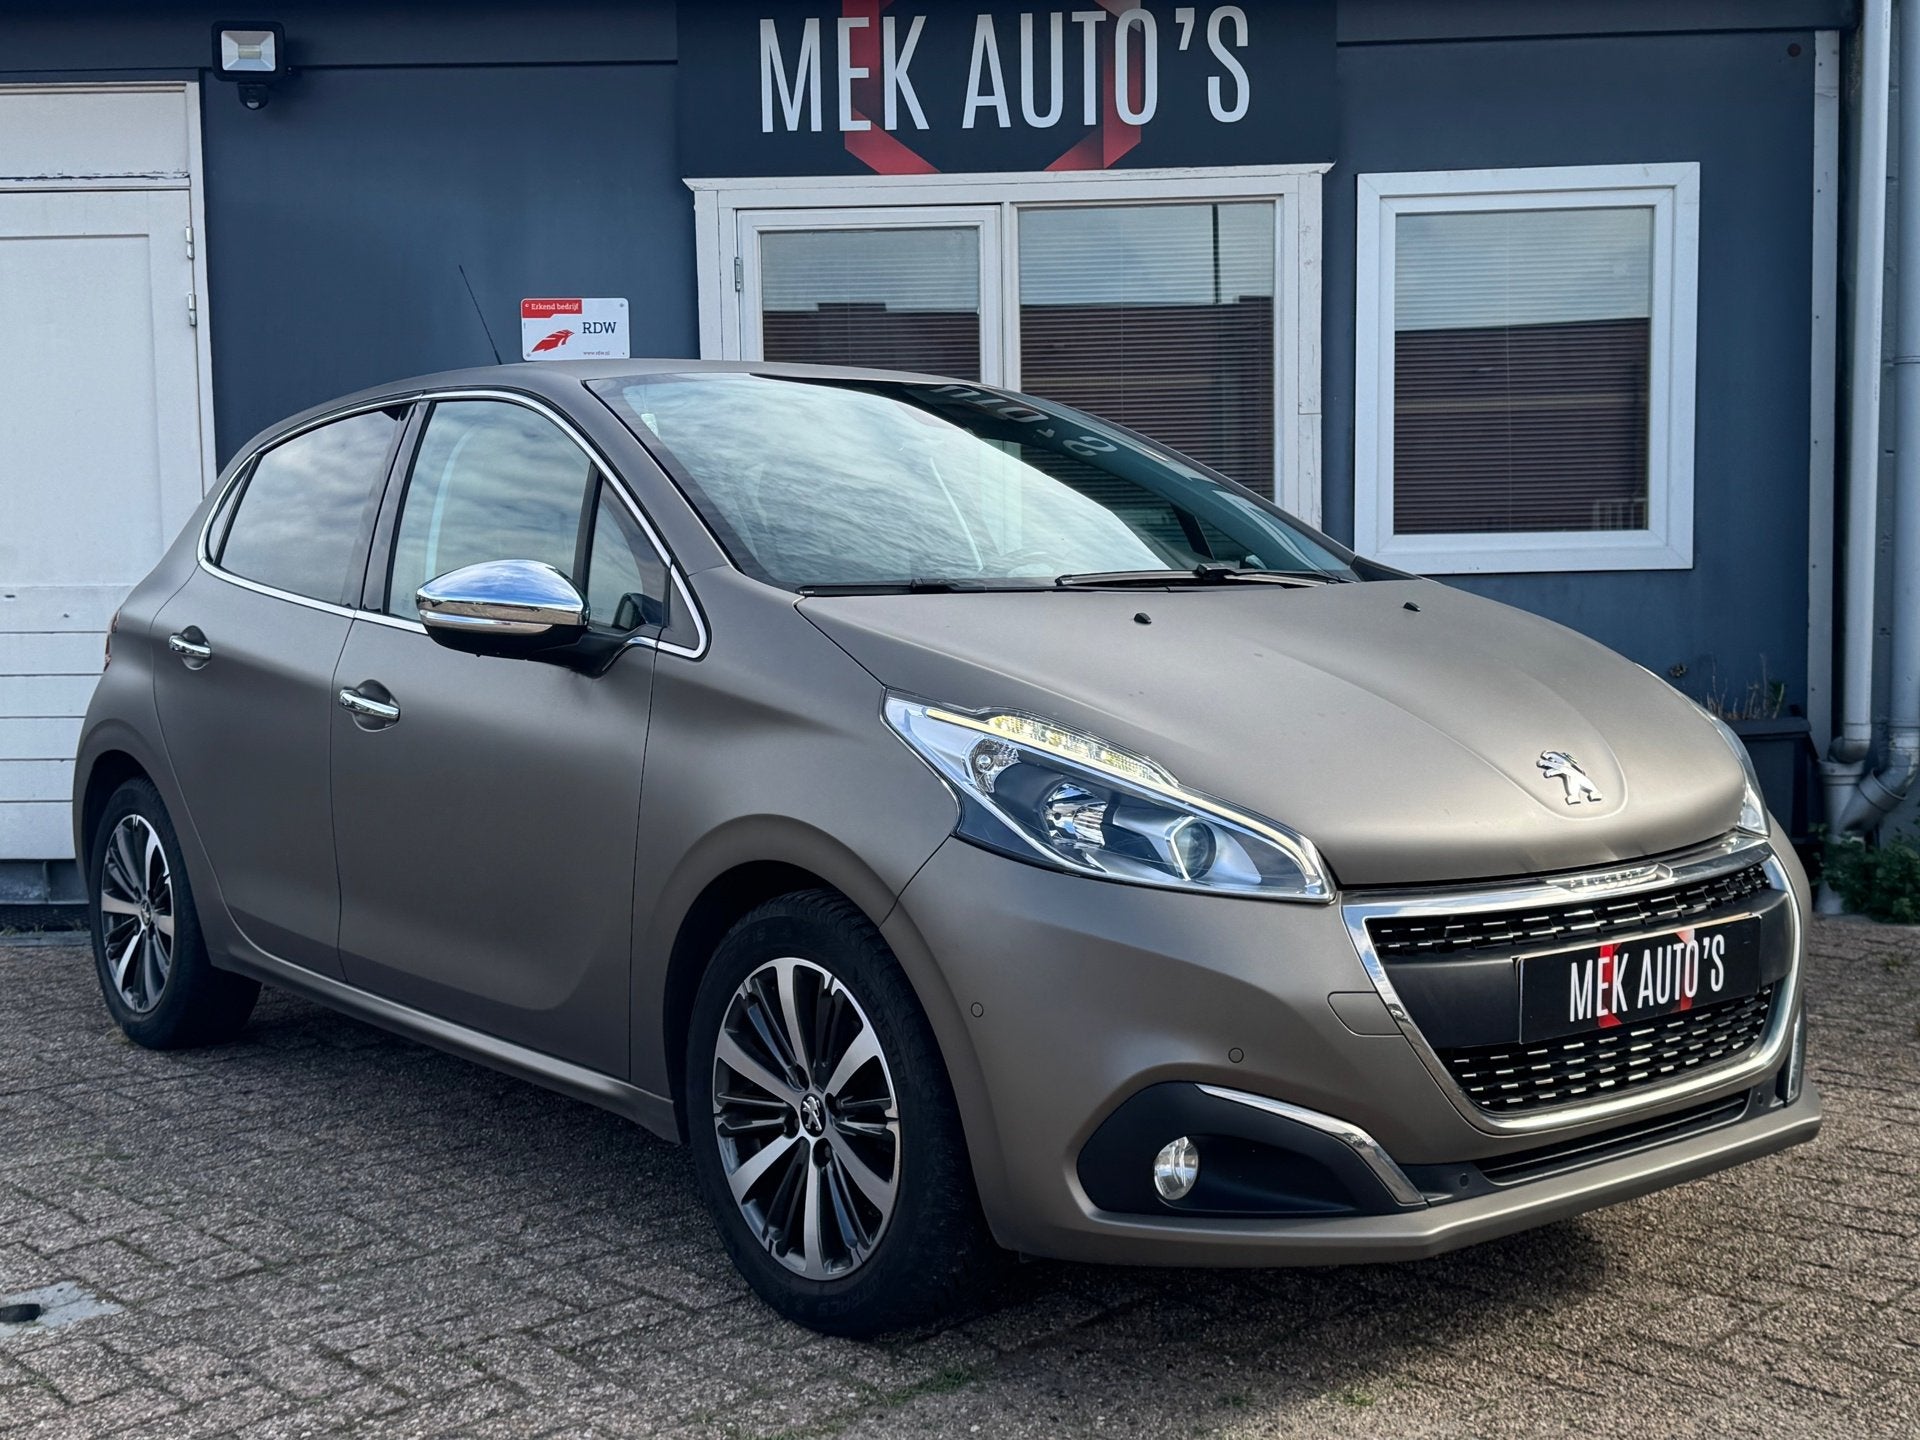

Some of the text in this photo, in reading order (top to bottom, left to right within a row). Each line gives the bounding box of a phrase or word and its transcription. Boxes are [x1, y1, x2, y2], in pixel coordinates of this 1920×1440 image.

[760, 5, 1250, 133] MEK AUTO'S
[531, 302, 579, 312] Erkend bedrijf
[582, 321, 617, 335] RDW
[1569, 934, 1725, 1023] MEK AUTO'S
